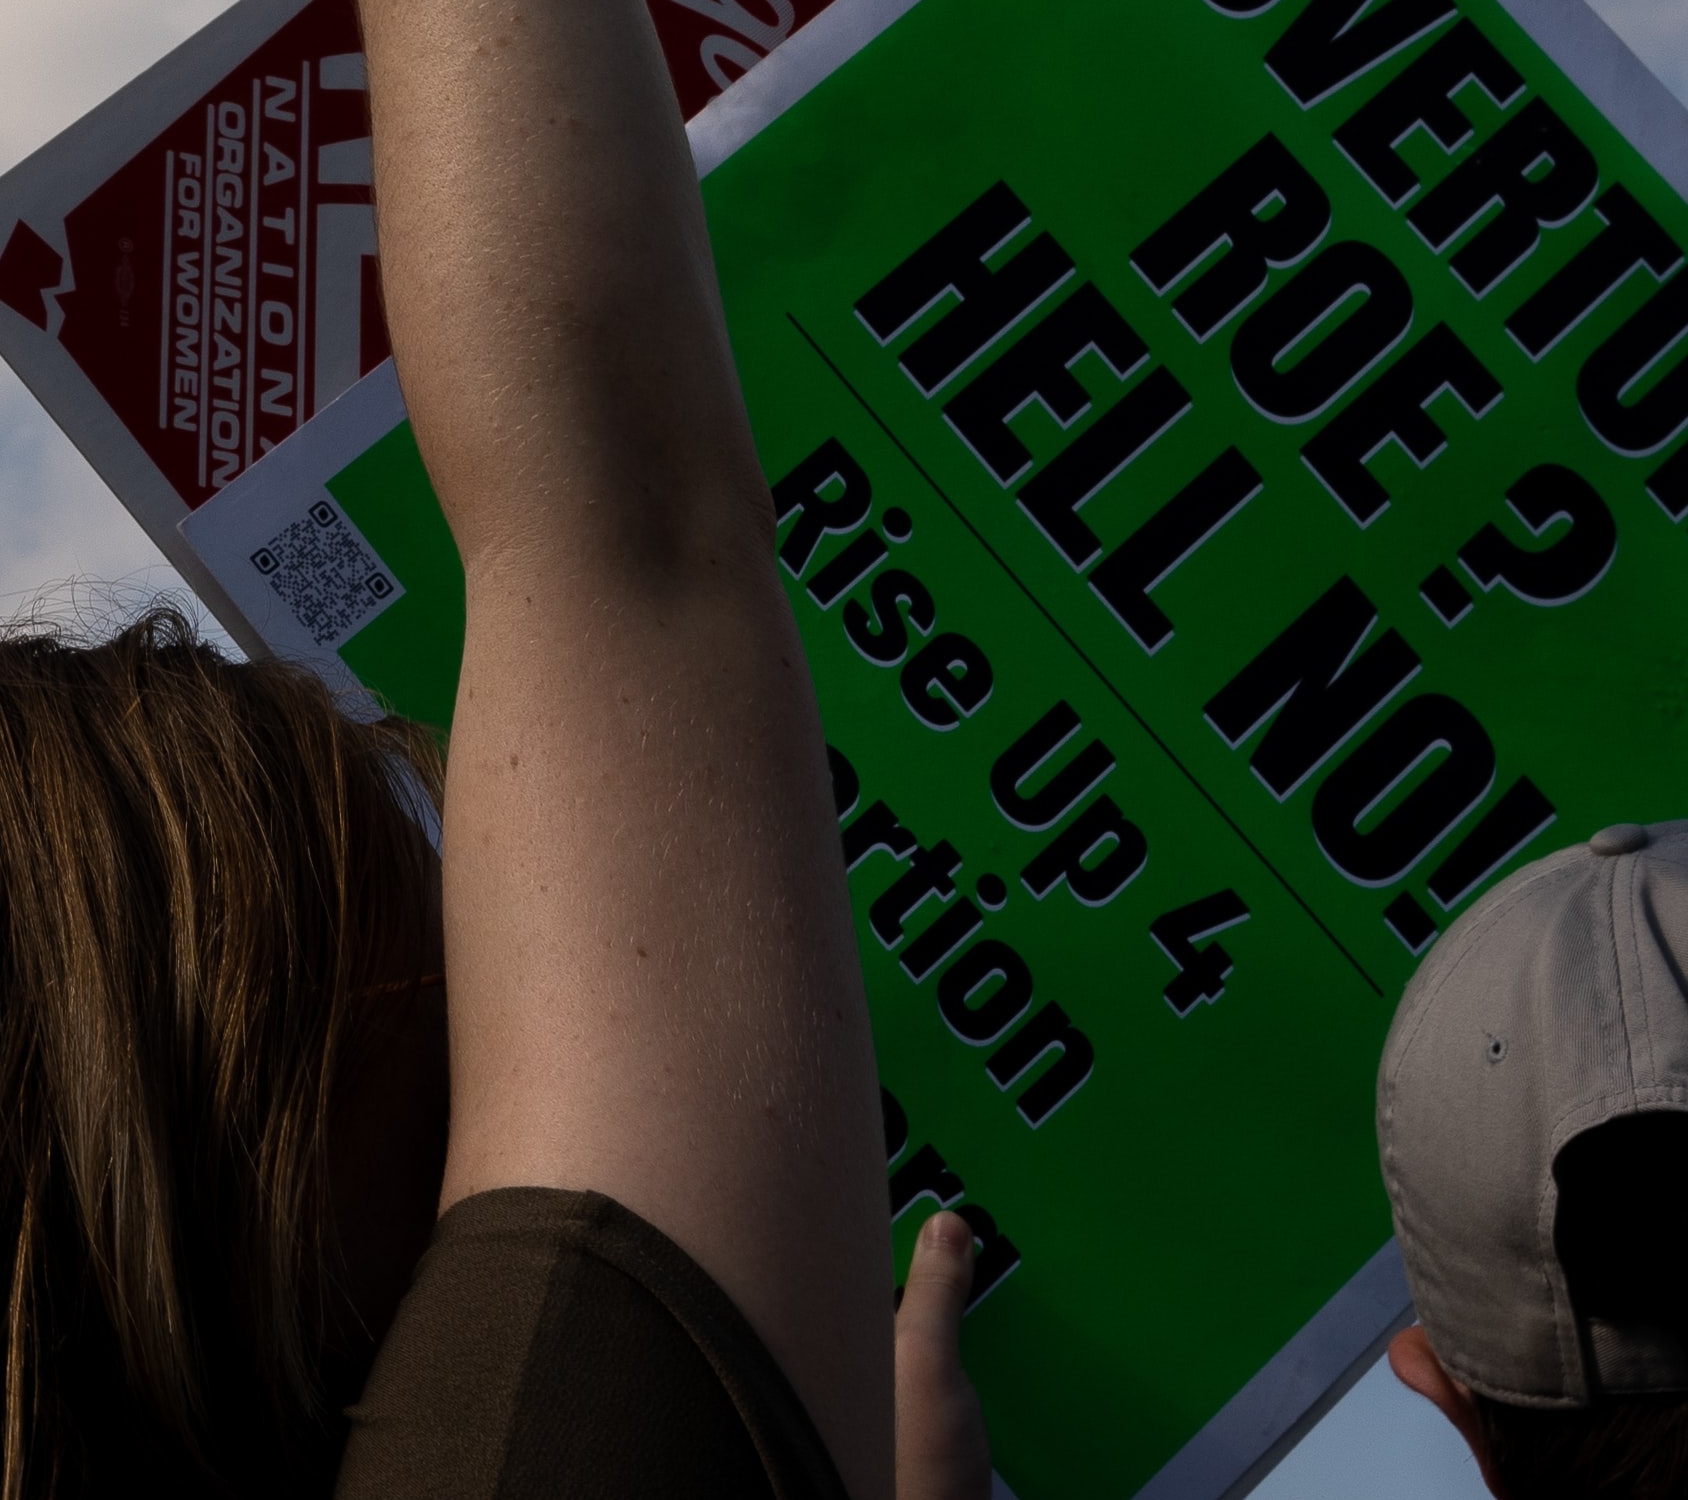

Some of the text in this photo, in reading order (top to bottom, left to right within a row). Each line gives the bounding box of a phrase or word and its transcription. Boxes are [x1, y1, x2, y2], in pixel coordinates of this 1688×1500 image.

[173, 151, 202, 432] FOR WOMEN
[211, 101, 246, 490] ORGANIZATION
[260, 74, 298, 452] NATION
[1129, 132, 1618, 629] ROE ?
[775, 437, 1252, 1020] Rise Up 4
[853, 178, 1264, 657] HELL
[1202, 574, 1558, 958] NO!
